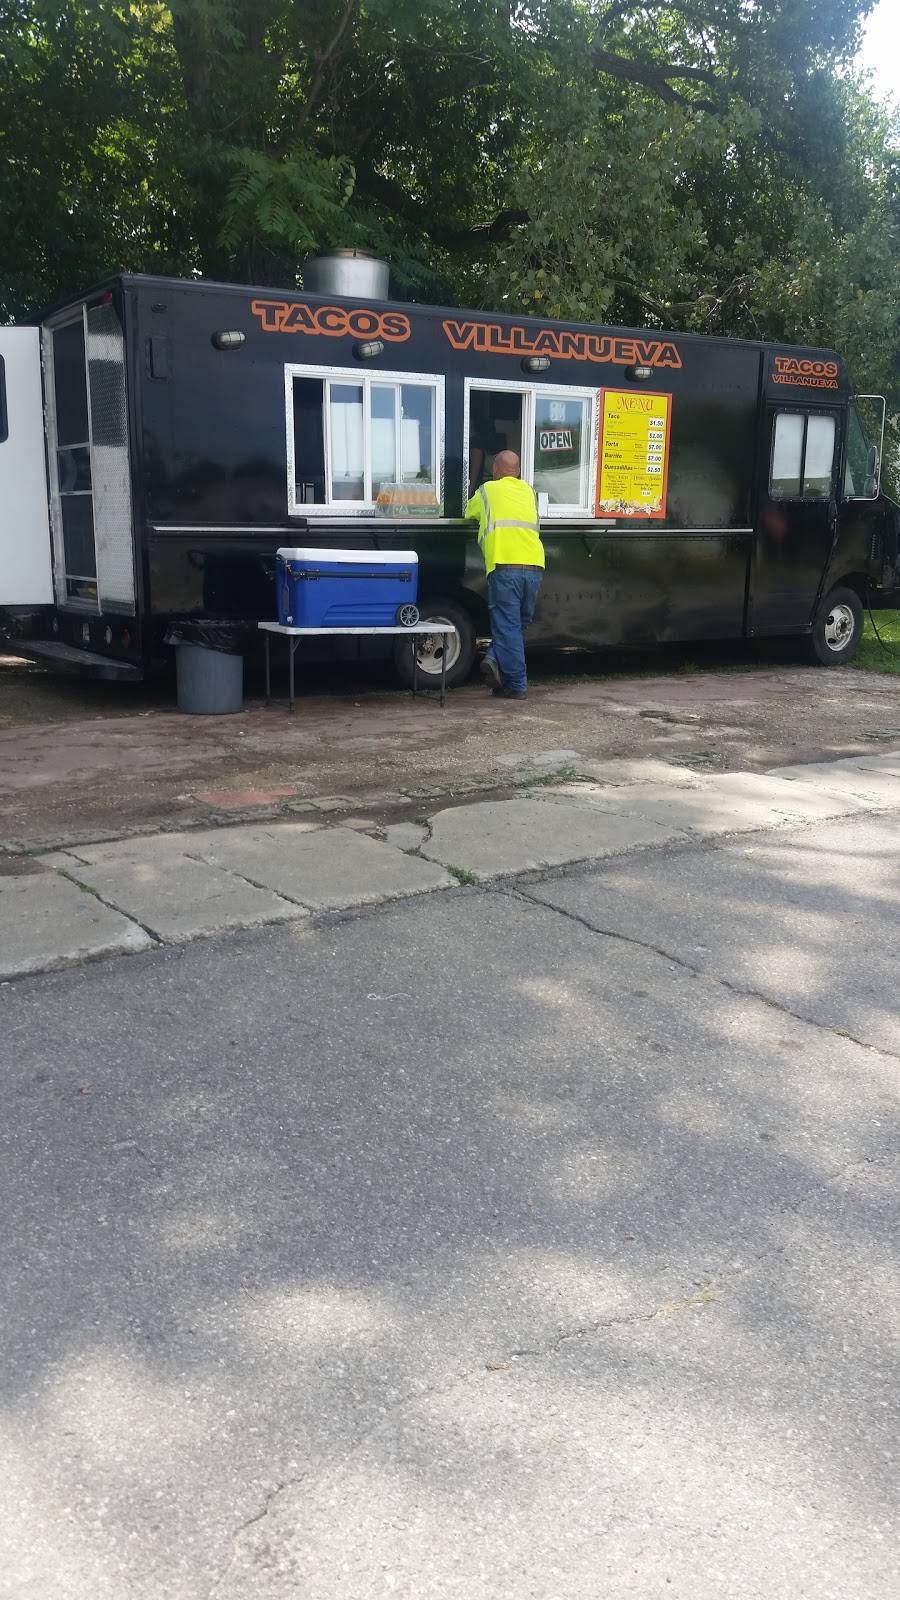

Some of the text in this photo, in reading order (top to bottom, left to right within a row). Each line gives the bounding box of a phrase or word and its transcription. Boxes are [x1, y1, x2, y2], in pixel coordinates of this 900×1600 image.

[251, 300, 683, 369] TACOS VILLANUEVA
[775, 356, 838, 377] TACOS
[772, 373, 838, 389] VILLANUEVA
[617, 396, 654, 412] MENU
[540, 431, 572, 449] OPEN
